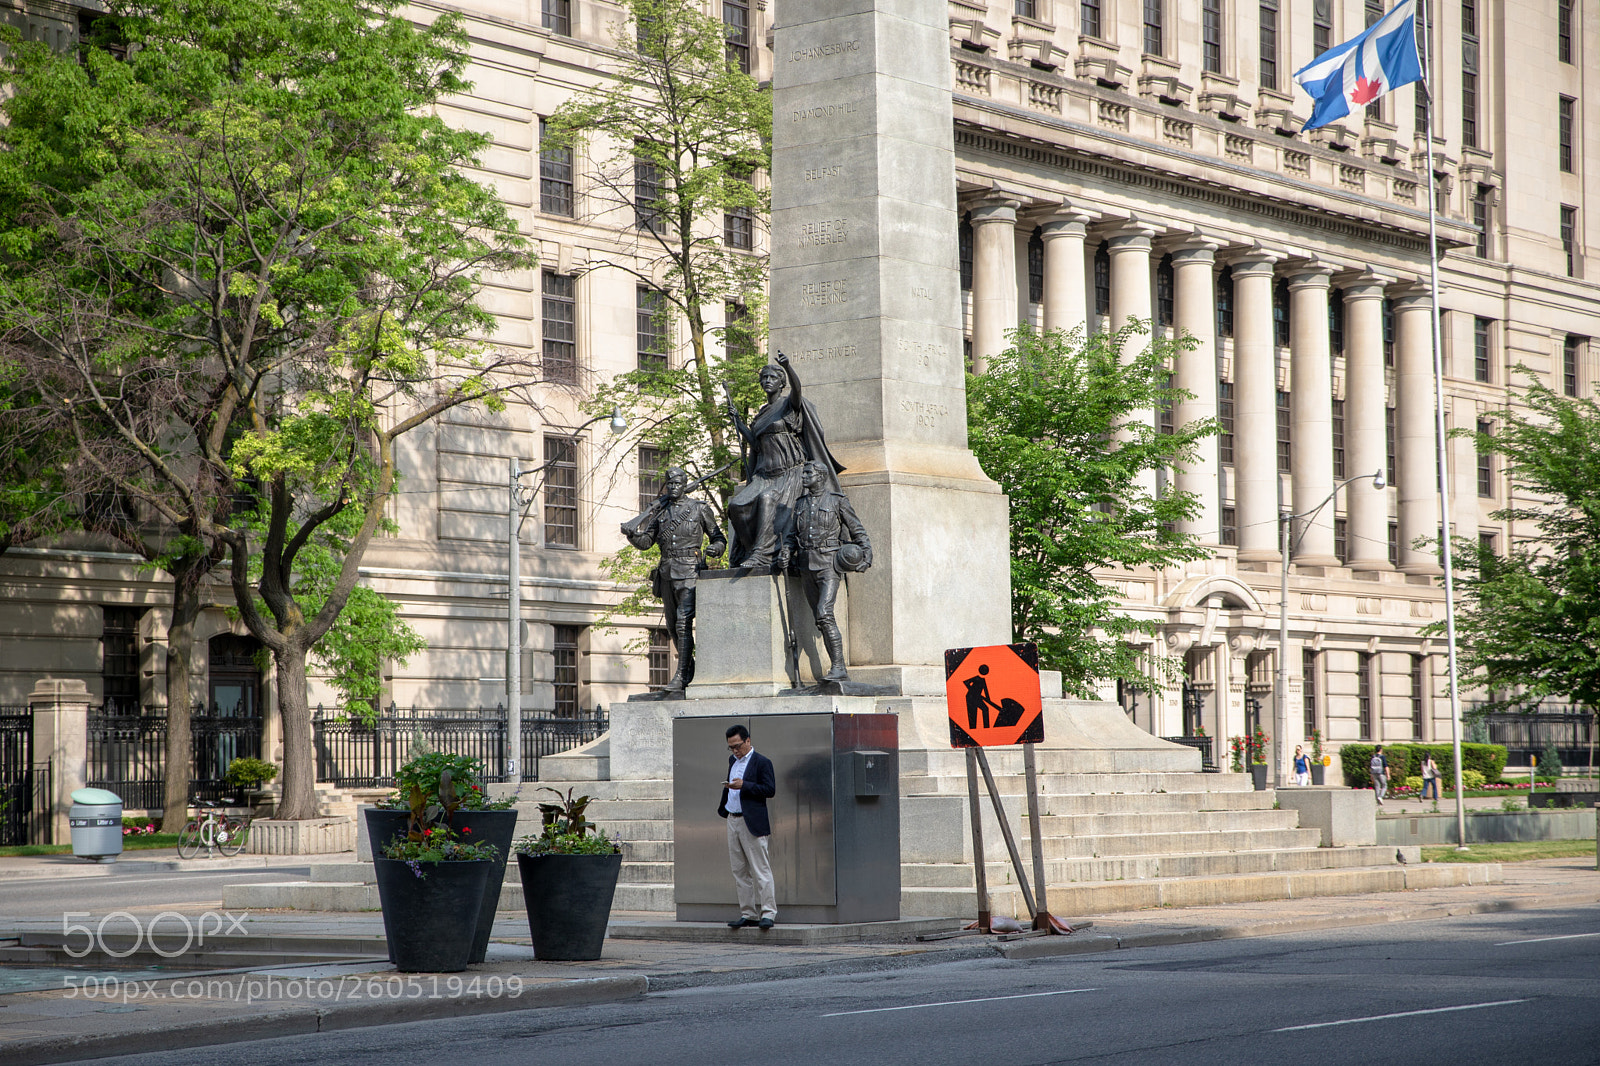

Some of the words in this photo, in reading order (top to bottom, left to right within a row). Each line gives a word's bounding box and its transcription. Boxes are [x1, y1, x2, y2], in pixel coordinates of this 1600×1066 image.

[793, 105, 835, 122] DIAMOND
[837, 102, 857, 115] HILL
[804, 165, 842, 181] BELFAST
[801, 220, 832, 235] RELIEF
[833, 218, 848, 231] OF
[802, 280, 832, 295] RELIEF
[833, 278, 848, 291] OF
[791, 348, 825, 362] HARTS
[827, 344, 857, 360] RIVER
